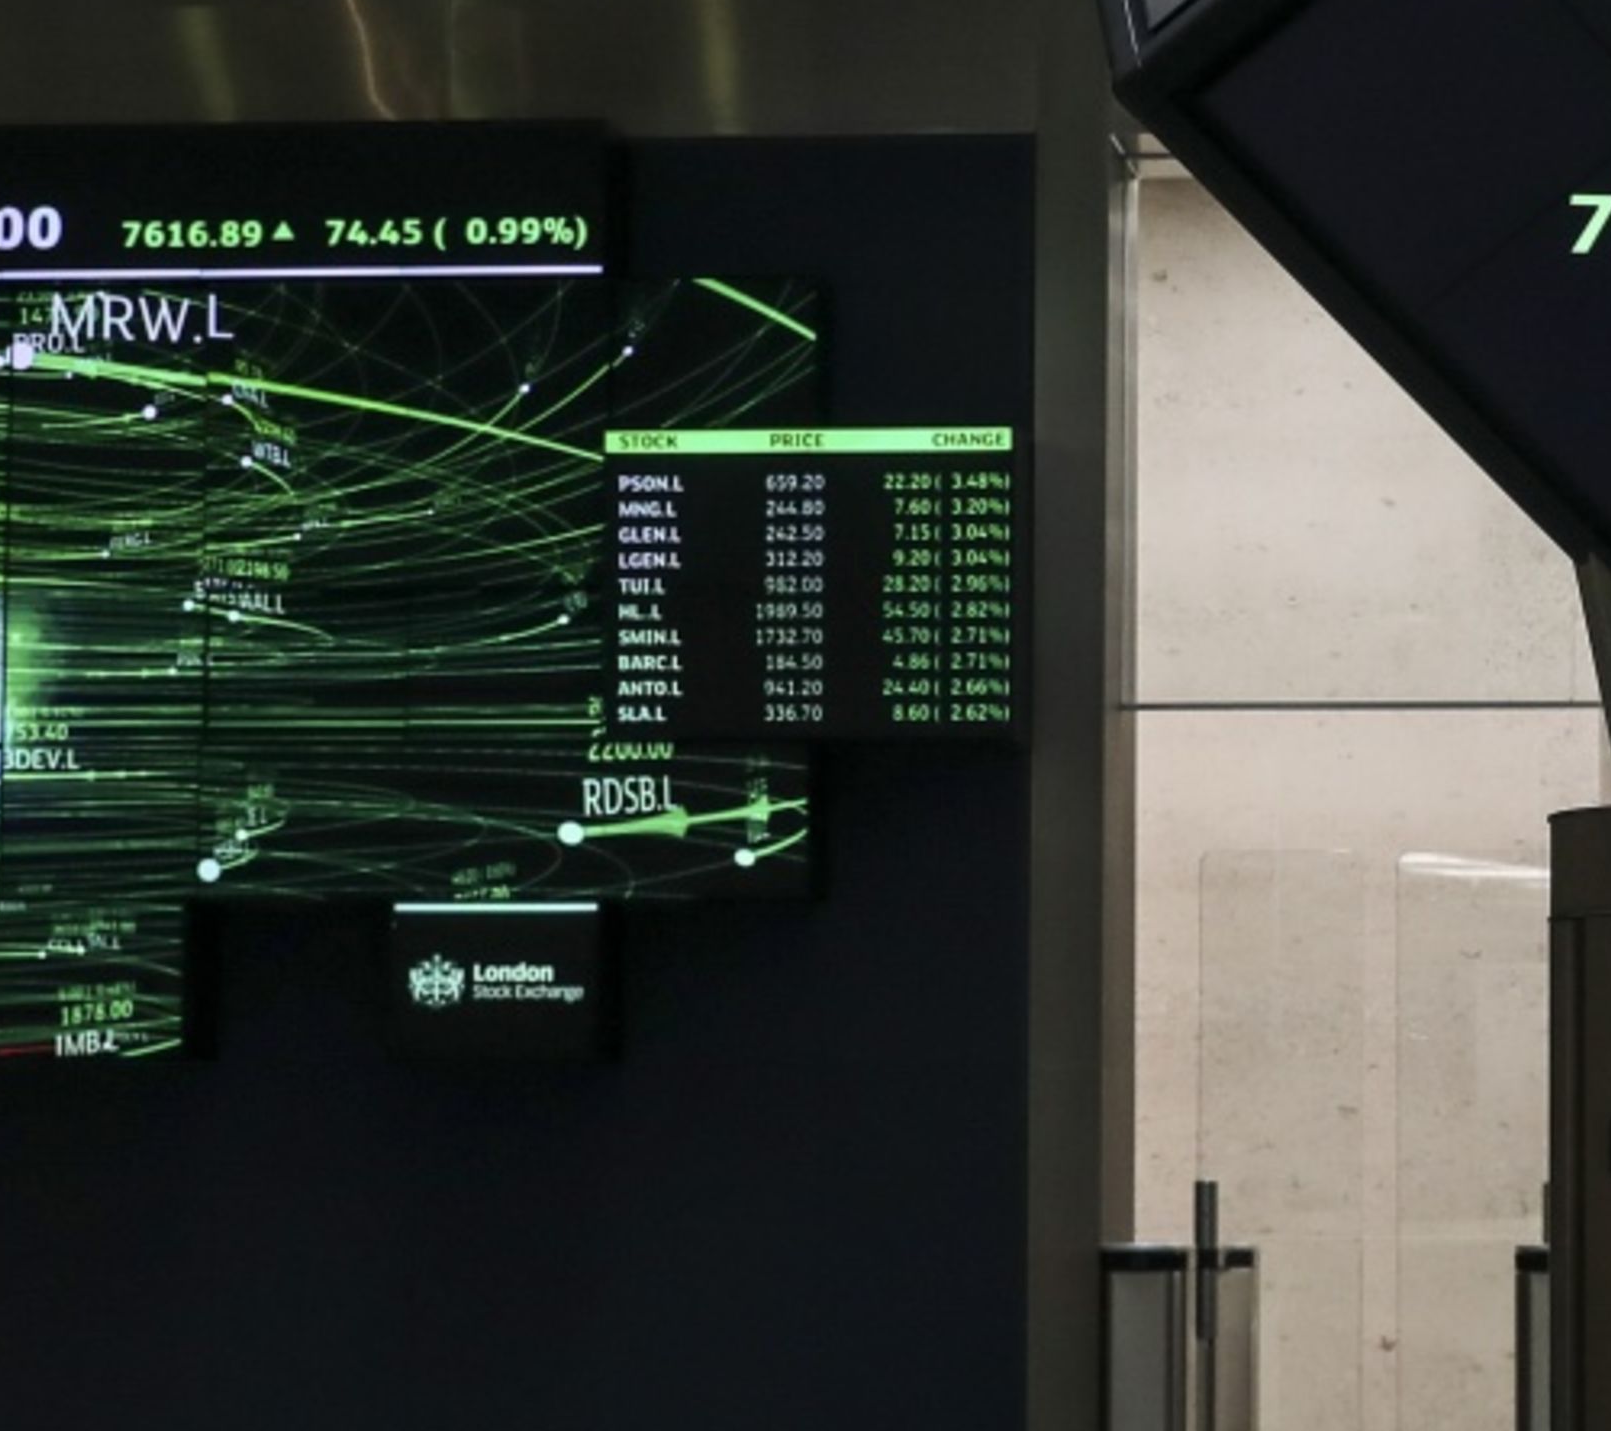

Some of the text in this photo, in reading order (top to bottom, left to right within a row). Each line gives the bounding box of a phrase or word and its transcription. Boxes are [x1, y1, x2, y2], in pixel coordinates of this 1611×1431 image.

[123, 221, 262, 247] 7616.89
[326, 219, 422, 245] 74.45
[466, 217, 587, 249] 0.99%)
[50, 292, 234, 344] MRW.L
[621, 434, 678, 449] STOCK
[770, 433, 823, 448] PRICE
[932, 432, 1004, 447] CHANGE
[619, 475, 683, 492] PSON.L
[619, 501, 675, 517] MNG.L
[619, 527, 680, 543] GLEN.L
[619, 552, 680, 569] LGEN.L
[619, 578, 664, 594] TUI.L
[619, 630, 680, 645] SMIN.L
[618, 655, 681, 670] BARC.L
[618, 681, 681, 696] ANTO.L
[618, 706, 665, 721] SLA.L
[583, 775, 678, 817] RDSB.L
[474, 963, 553, 982] London
[473, 985, 584, 1002] Stock Exchange
